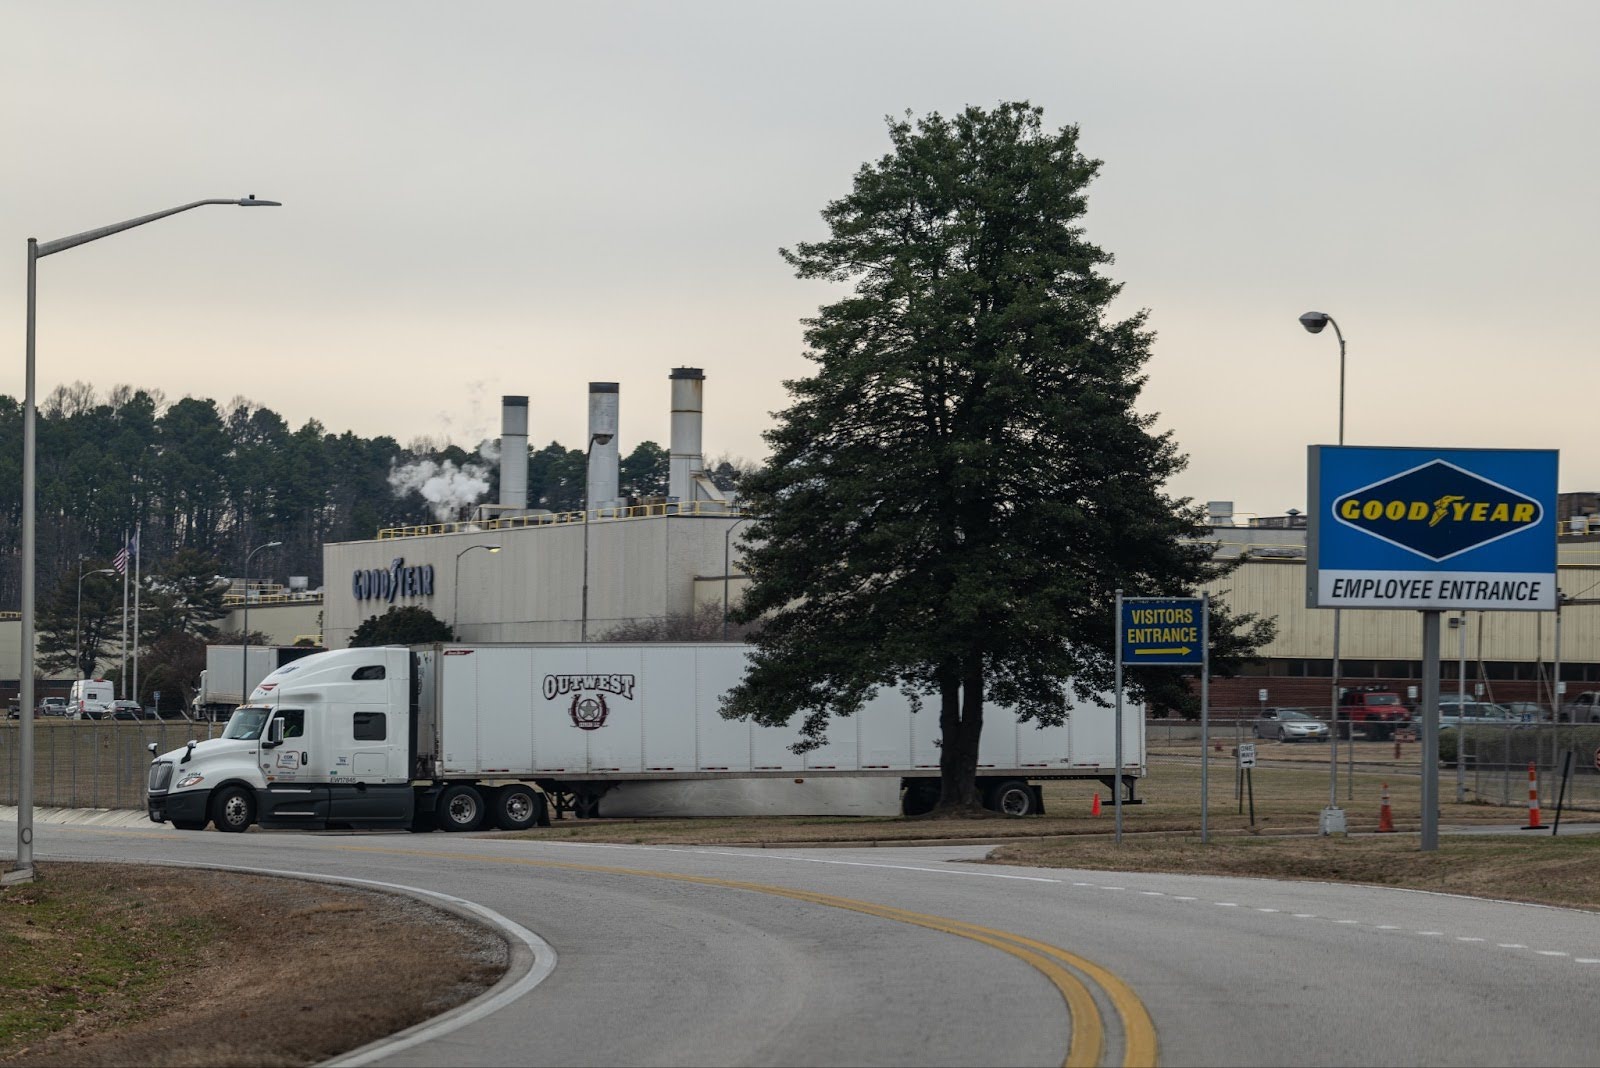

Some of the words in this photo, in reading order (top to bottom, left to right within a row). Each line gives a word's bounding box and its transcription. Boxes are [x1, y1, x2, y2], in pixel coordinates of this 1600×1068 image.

[1341, 499, 1535, 523] GOODYEAR
[352, 564, 434, 601] GOODYEAR
[1332, 578, 1433, 599] EMPLOYEE
[1438, 580, 1541, 601] ENTRANCE
[1131, 608, 1194, 625] VISITORS
[1127, 627, 1197, 644] ENTRANCE
[542, 674, 635, 700] OUTWEST
